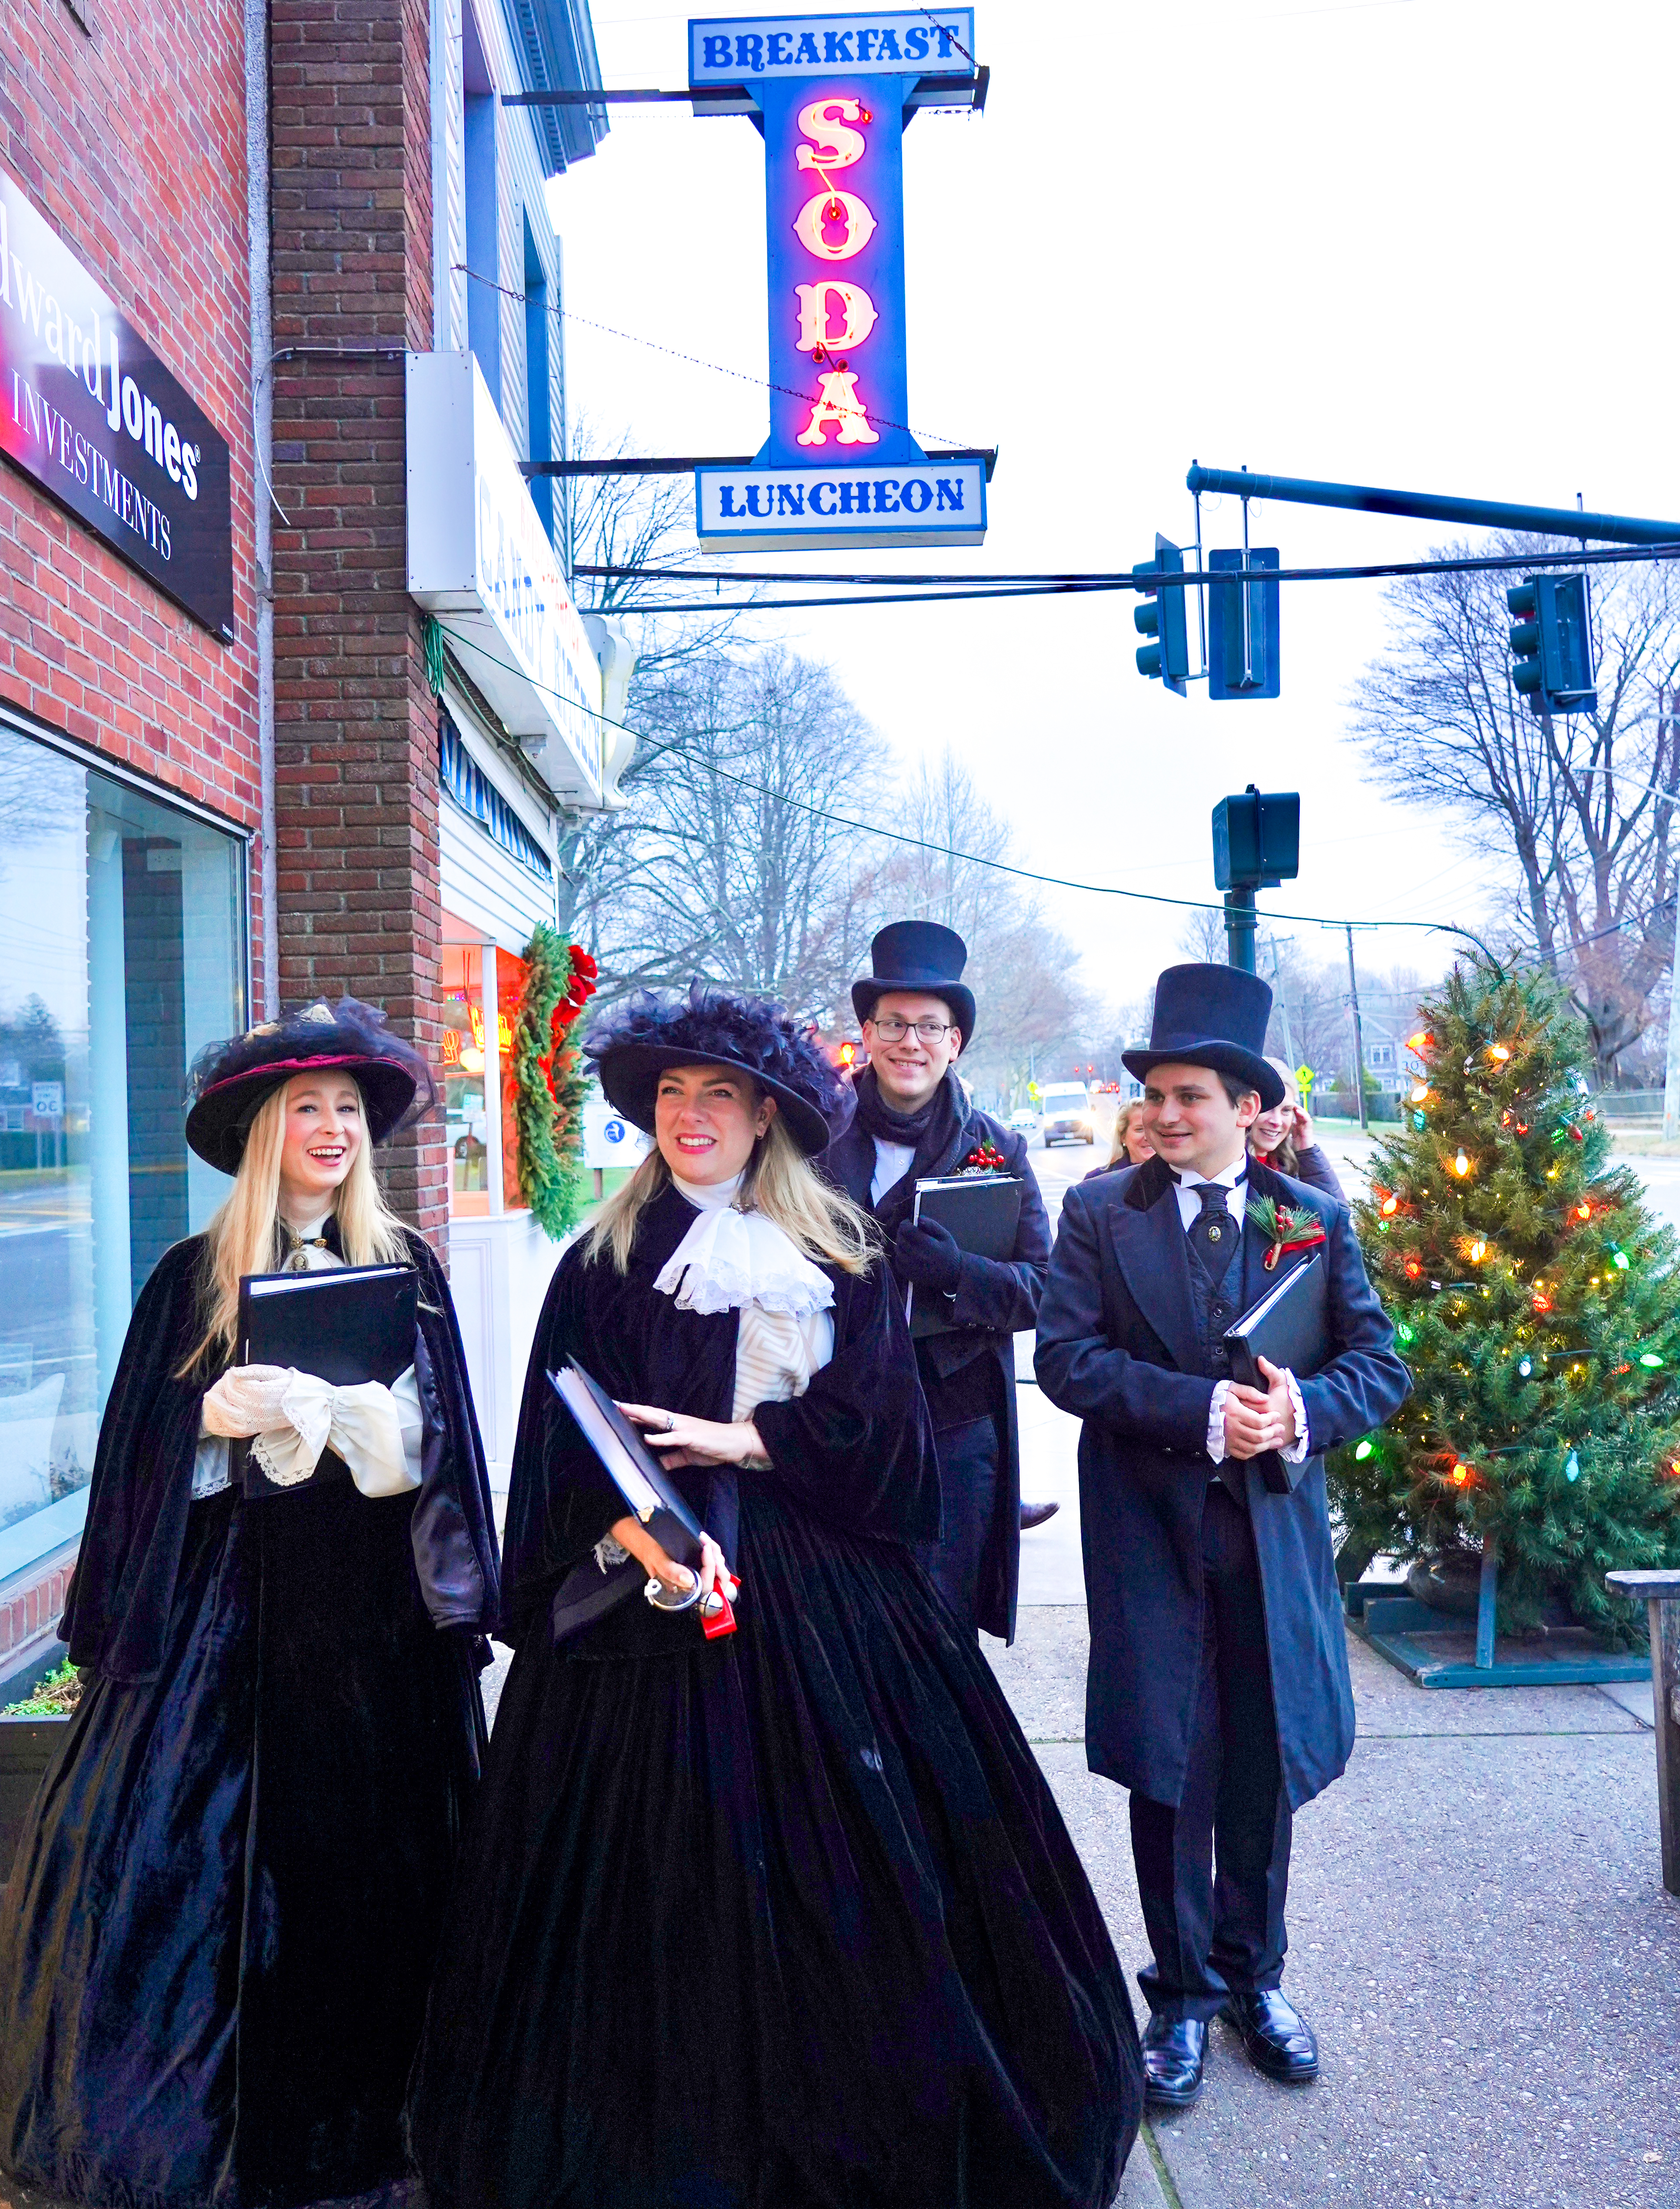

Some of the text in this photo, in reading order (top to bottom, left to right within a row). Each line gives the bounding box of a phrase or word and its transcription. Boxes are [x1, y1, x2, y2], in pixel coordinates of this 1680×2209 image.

[702, 25, 959, 72] BREAKFAST
[792, 98, 880, 445] SODA
[11, 368, 172, 560] INVESTMENTS
[719, 478, 964, 517] LUNCHEON
[480, 474, 600, 789] CANDY KITCHEN
